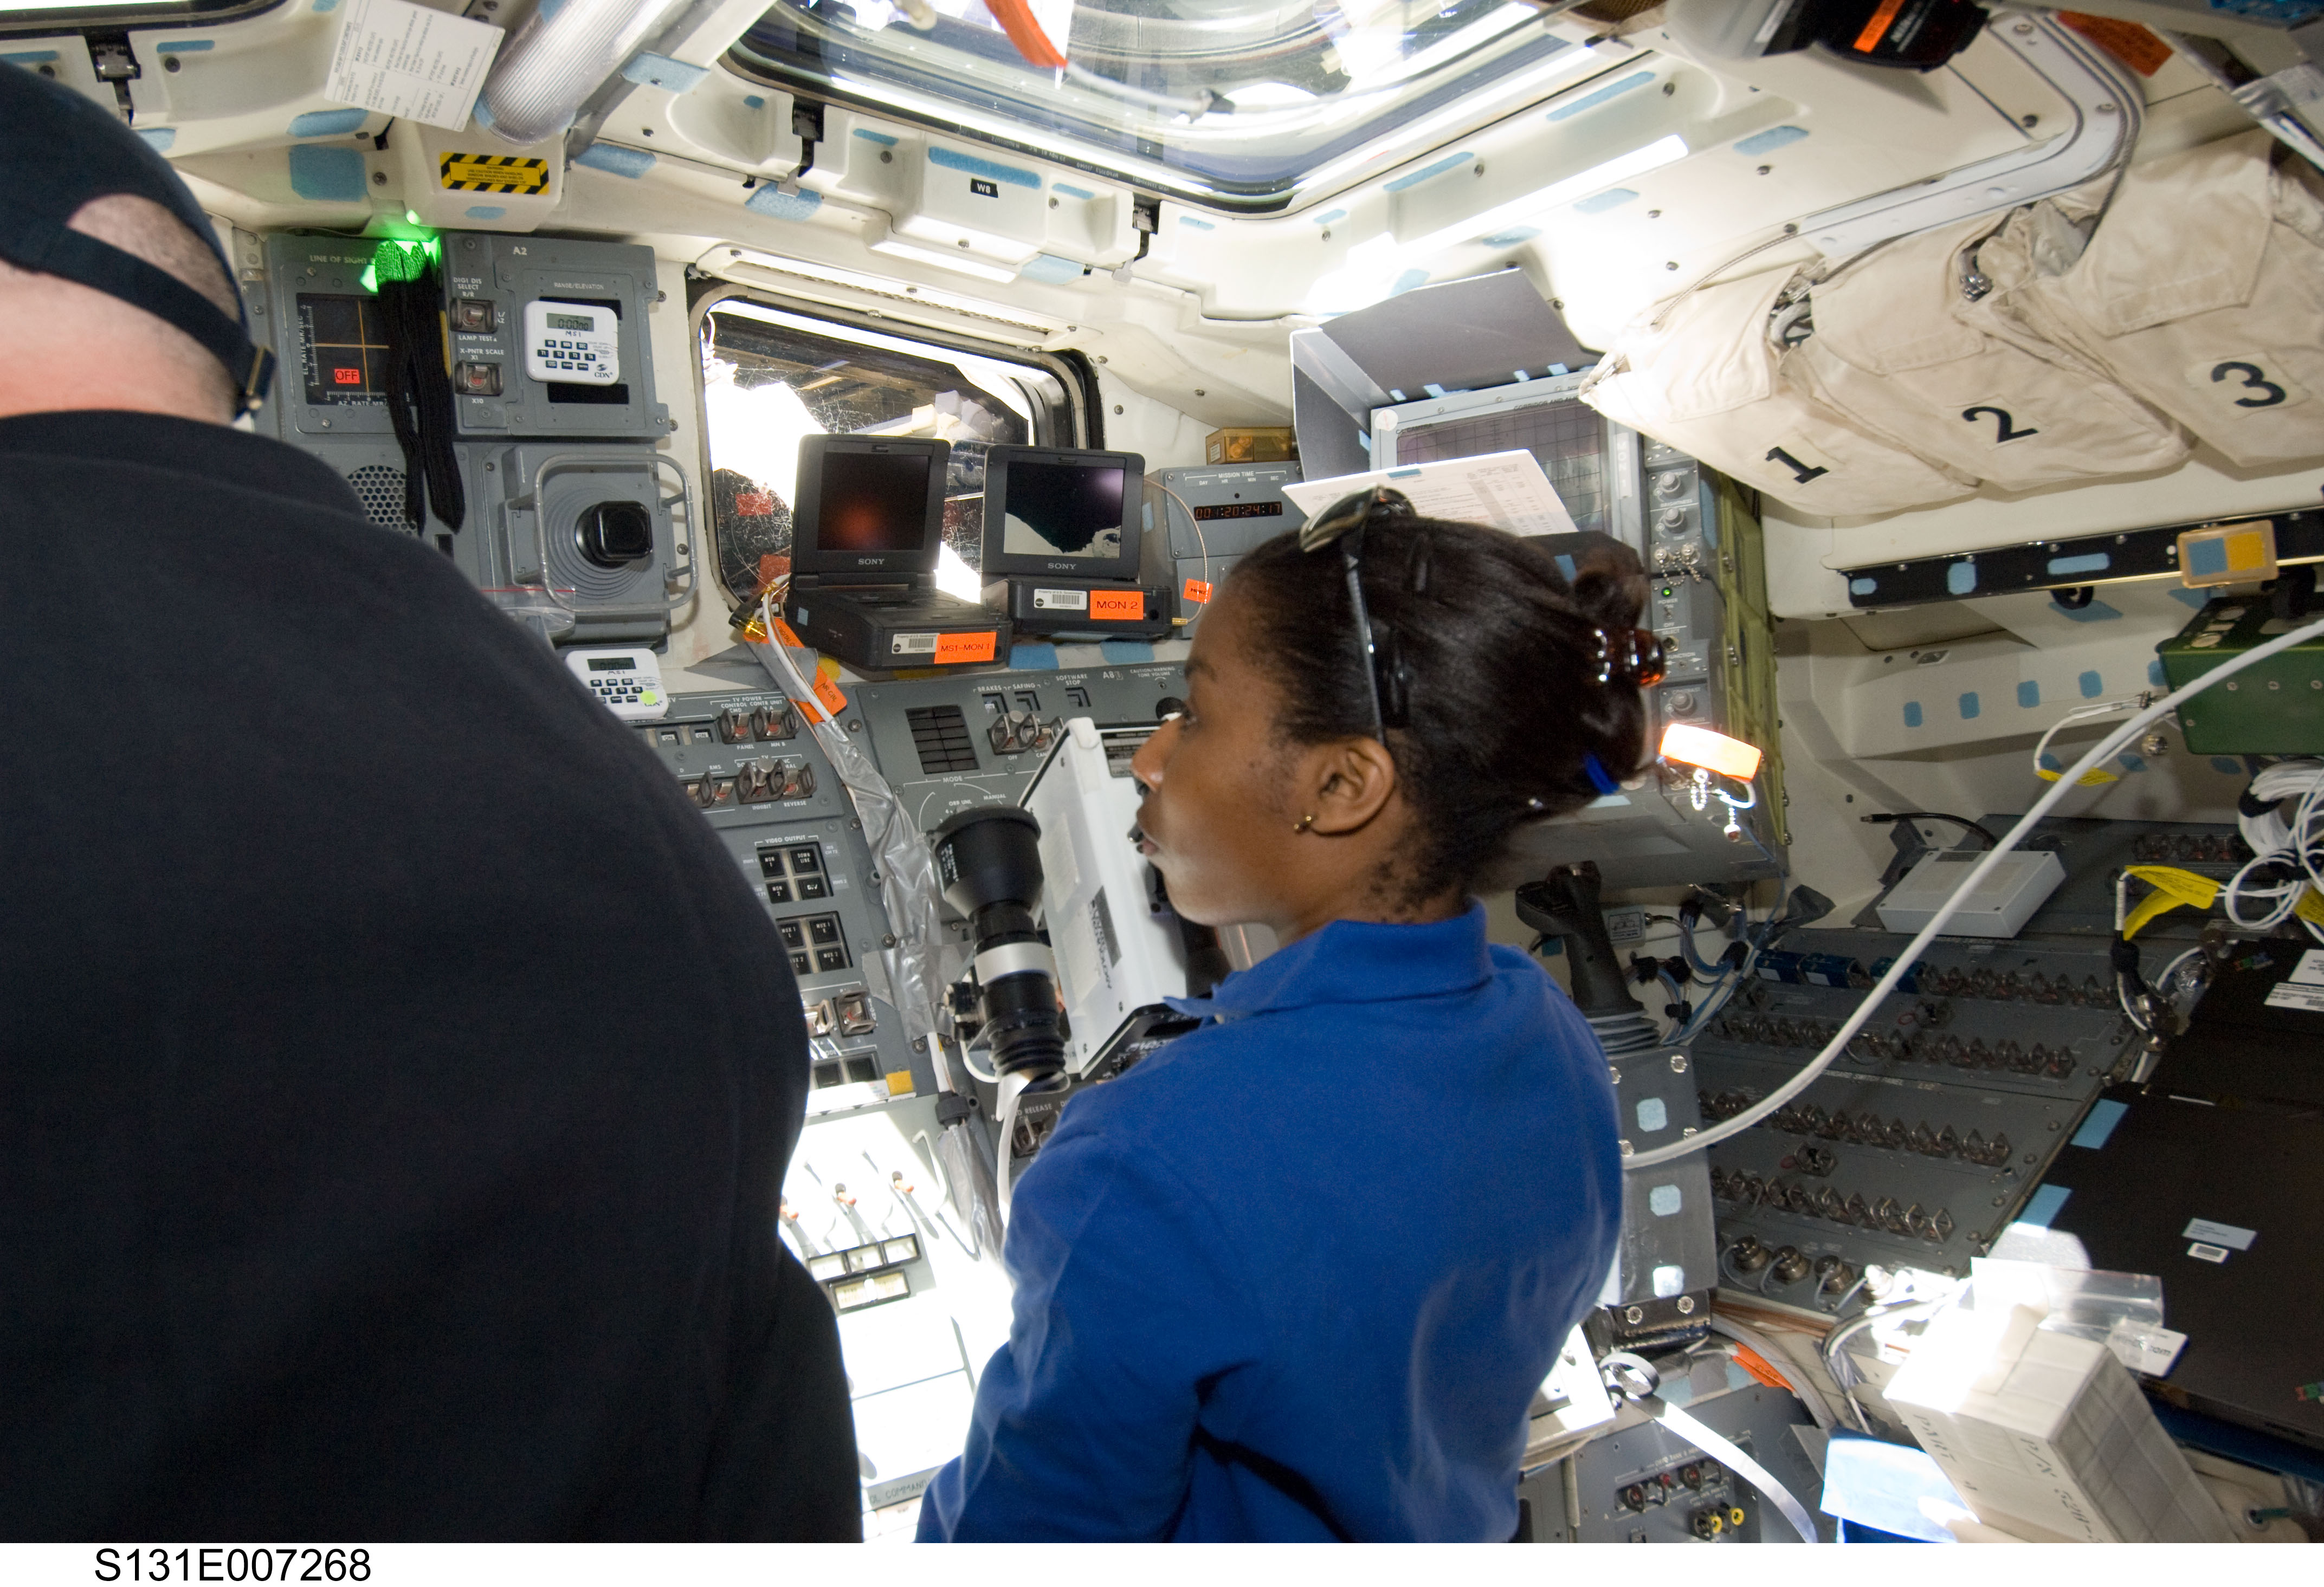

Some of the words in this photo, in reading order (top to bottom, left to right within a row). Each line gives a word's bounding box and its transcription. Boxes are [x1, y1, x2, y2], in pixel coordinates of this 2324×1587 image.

[977, 183, 991, 194] W8
[513, 247, 527, 255] A2
[344, 256, 367, 264] SIGHT
[554, 282, 604, 290] RANGE/ELEVATION
[335, 370, 358, 380] OFF
[2210, 360, 2287, 409] 3
[1513, 400, 1548, 411] CORRIDOR
[1961, 405, 2039, 444] 2
[1764, 445, 1830, 485] 1
[1047, 562, 1077, 571] SONY
[1096, 600, 1127, 609] MON
[1131, 601, 1138, 610] 2
[977, 684, 1002, 692] BRAKES
[942, 775, 964, 783] MODE
[1024, 1103, 1053, 1115] RELEASE
